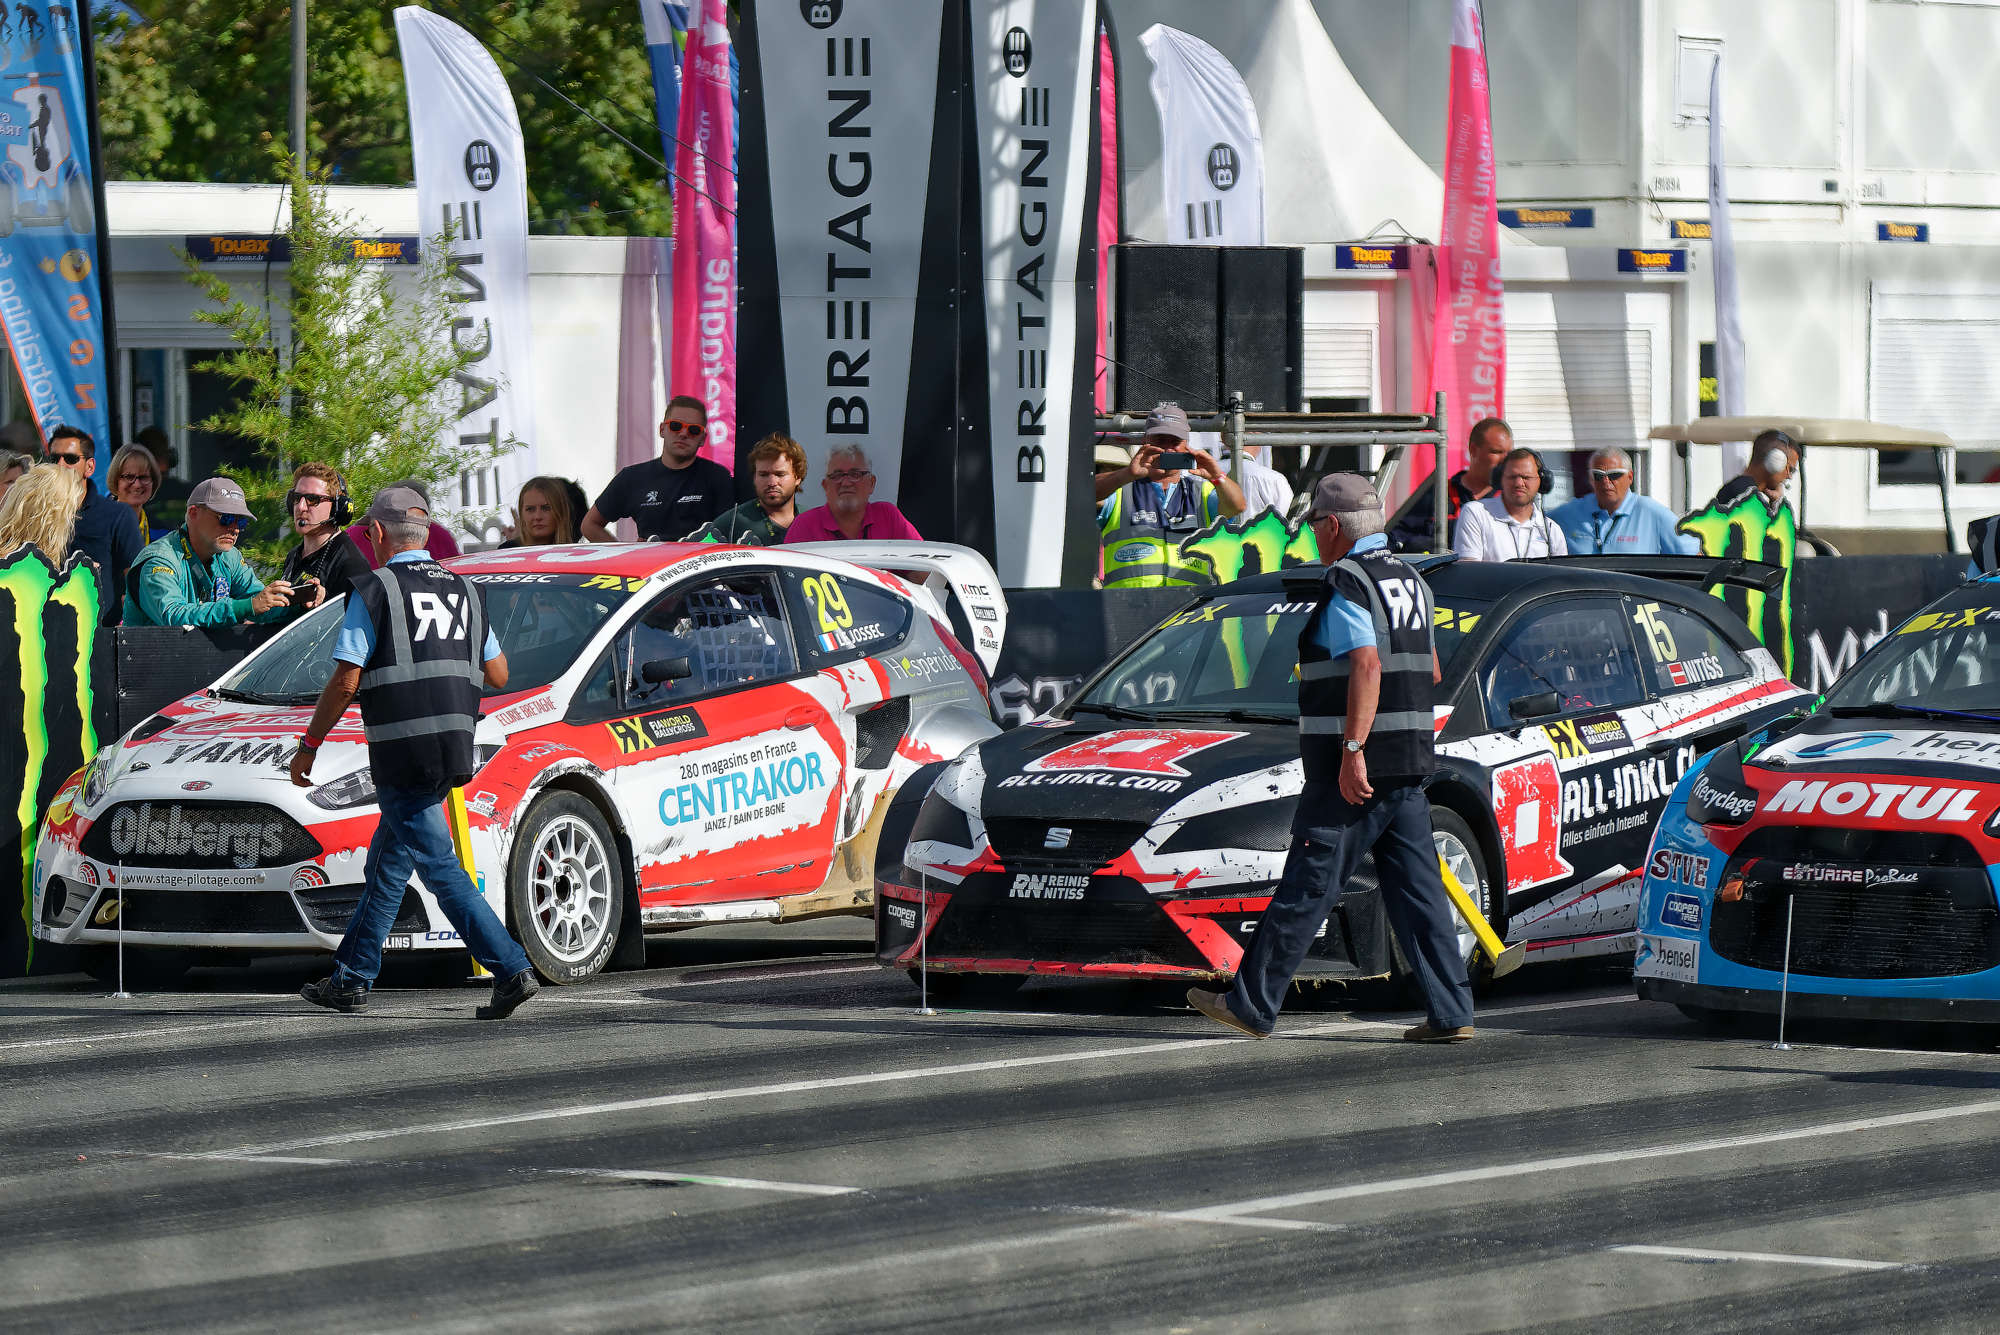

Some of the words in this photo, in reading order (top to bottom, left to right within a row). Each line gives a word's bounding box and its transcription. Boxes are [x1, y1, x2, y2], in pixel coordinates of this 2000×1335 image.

[826, 36, 871, 434] BRETAGNE
[209, 236, 270, 254] Touax
[1349, 246, 1394, 264] Touax
[1630, 250, 1673, 267] Touax
[1016, 86, 1049, 482] BRETAGNE
[802, 572, 853, 633] 29
[1633, 602, 1678, 663] 15
[680, 763, 700, 780] 280
[702, 753, 749, 776] magasins
[750, 750, 764, 763] en
[764, 741, 798, 760] France
[658, 751, 826, 827] CENTRAKOR
[1763, 780, 1981, 822] MOTUL
[704, 816, 727, 833] JANZE
[733, 810, 753, 826] BAIN
[753, 808, 764, 820] DE
[764, 802, 786, 819] BGNE
[110, 803, 283, 868] Olsbergs
[1562, 830, 1583, 848] Alles
[1584, 819, 1615, 840] einfach
[1616, 809, 1649, 831] Internet
[126, 874, 257, 887] www.stage-pilotage.com
[1048, 876, 1091, 888] REINIS
[1864, 868, 1920, 887] ProRace
[1044, 886, 1085, 900] NITISS
[888, 904, 917, 921] COOPER
[1668, 900, 1700, 915] COOPER
[900, 918, 916, 929] TIRES
[1681, 912, 1699, 923] TIRES
[382, 936, 411, 949] LINS
[1656, 938, 1696, 969] hensel
